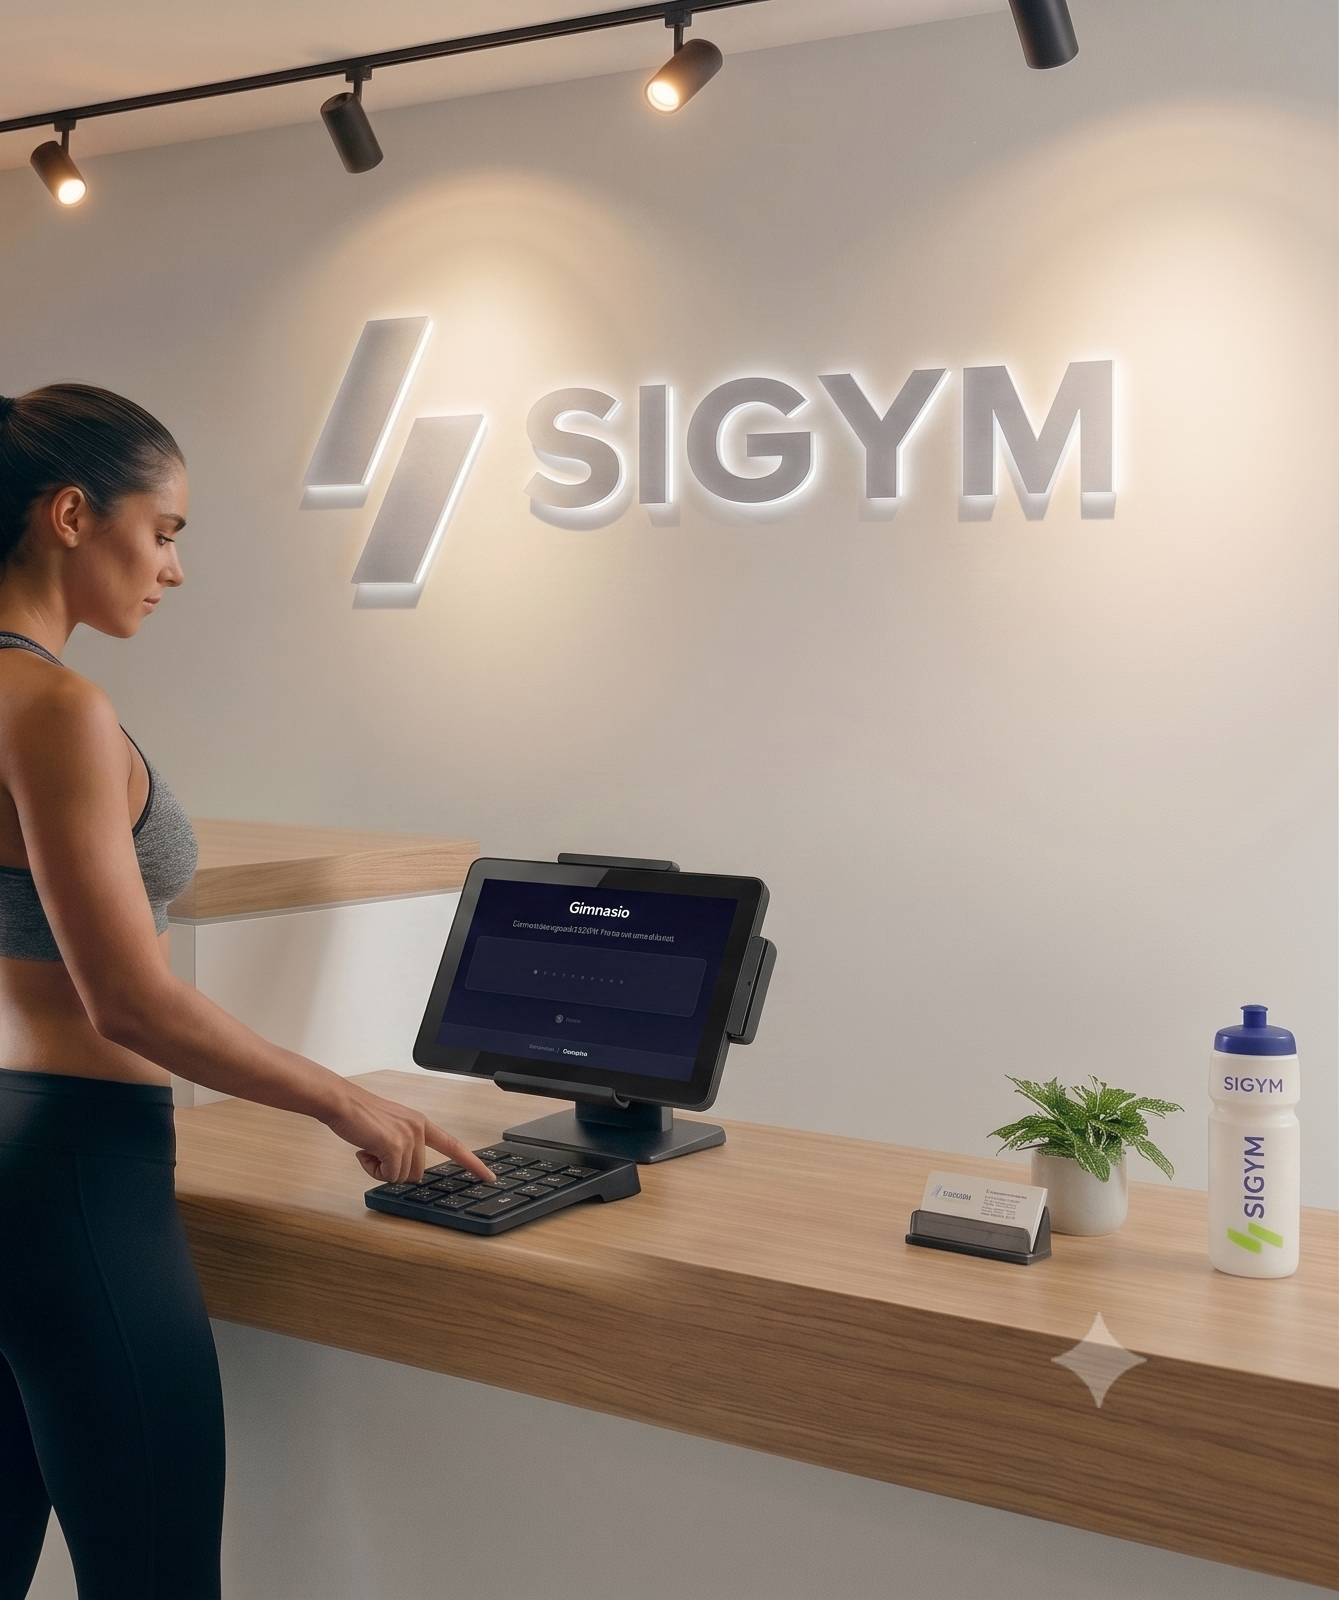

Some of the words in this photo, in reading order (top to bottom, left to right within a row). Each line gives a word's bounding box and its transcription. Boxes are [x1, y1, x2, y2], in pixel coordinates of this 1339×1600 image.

[523, 358, 1118, 514] SIGYM
[569, 901, 630, 918] Gimnasio
[1223, 1076, 1284, 1094] SIGYM
[1243, 1136, 1265, 1219] SIGYM
